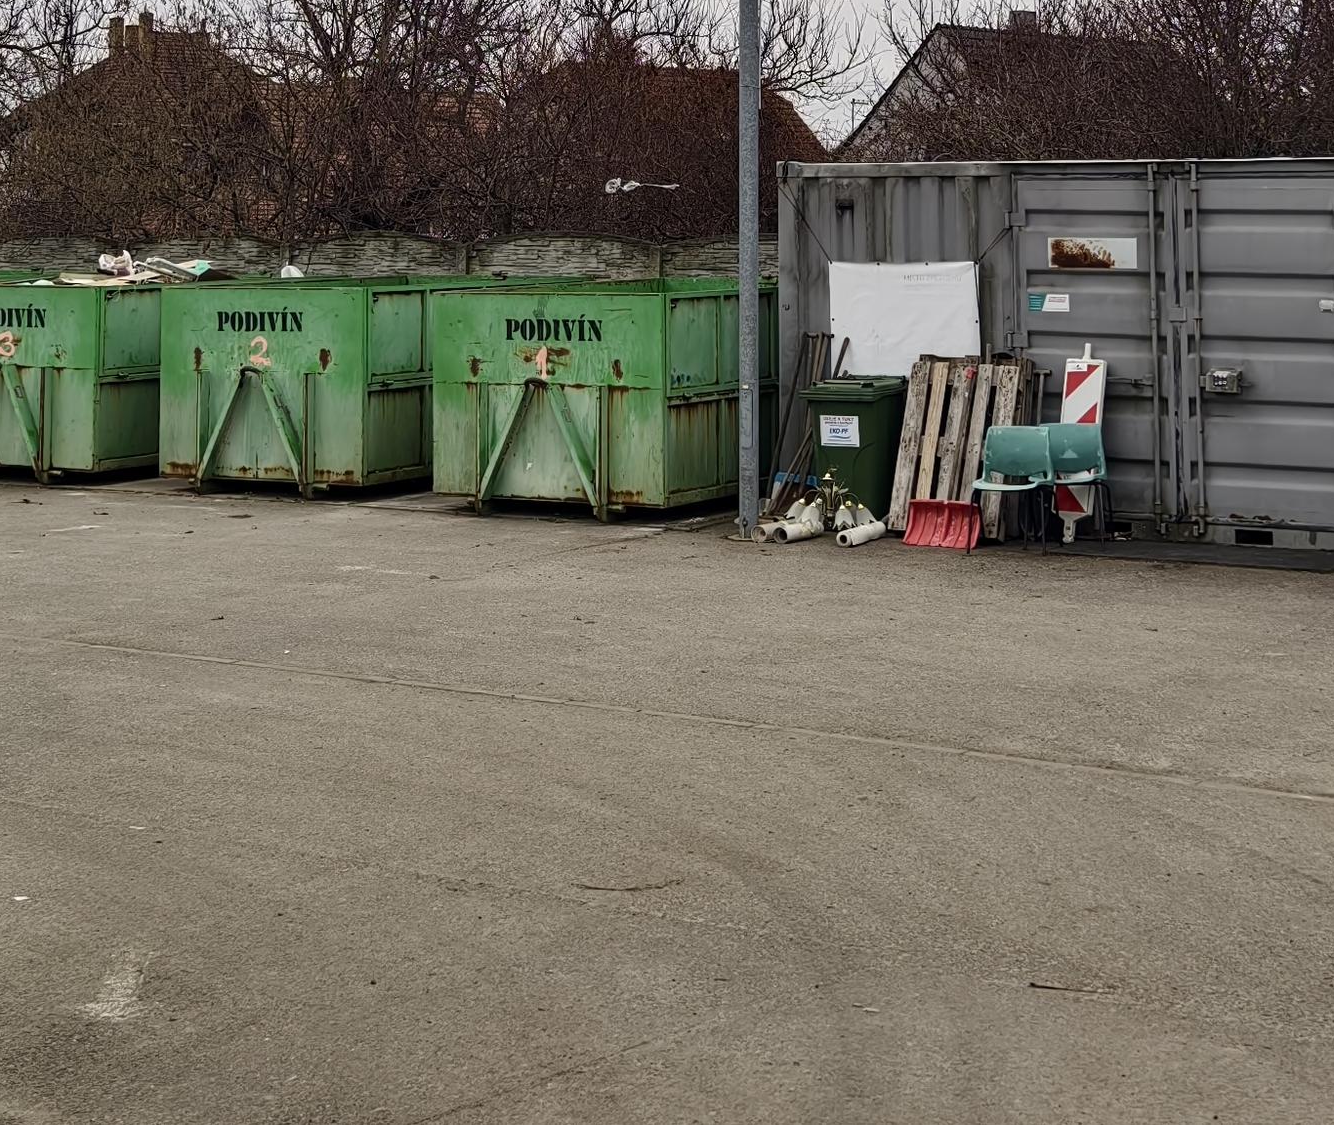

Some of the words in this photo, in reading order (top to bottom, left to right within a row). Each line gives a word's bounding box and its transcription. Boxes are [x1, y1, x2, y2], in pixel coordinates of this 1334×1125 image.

[217, 306, 304, 332] PODIVÍN
[505, 313, 603, 342] PODIVÍN
[250, 335, 272, 367] 2
[535, 345, 548, 380] 1
